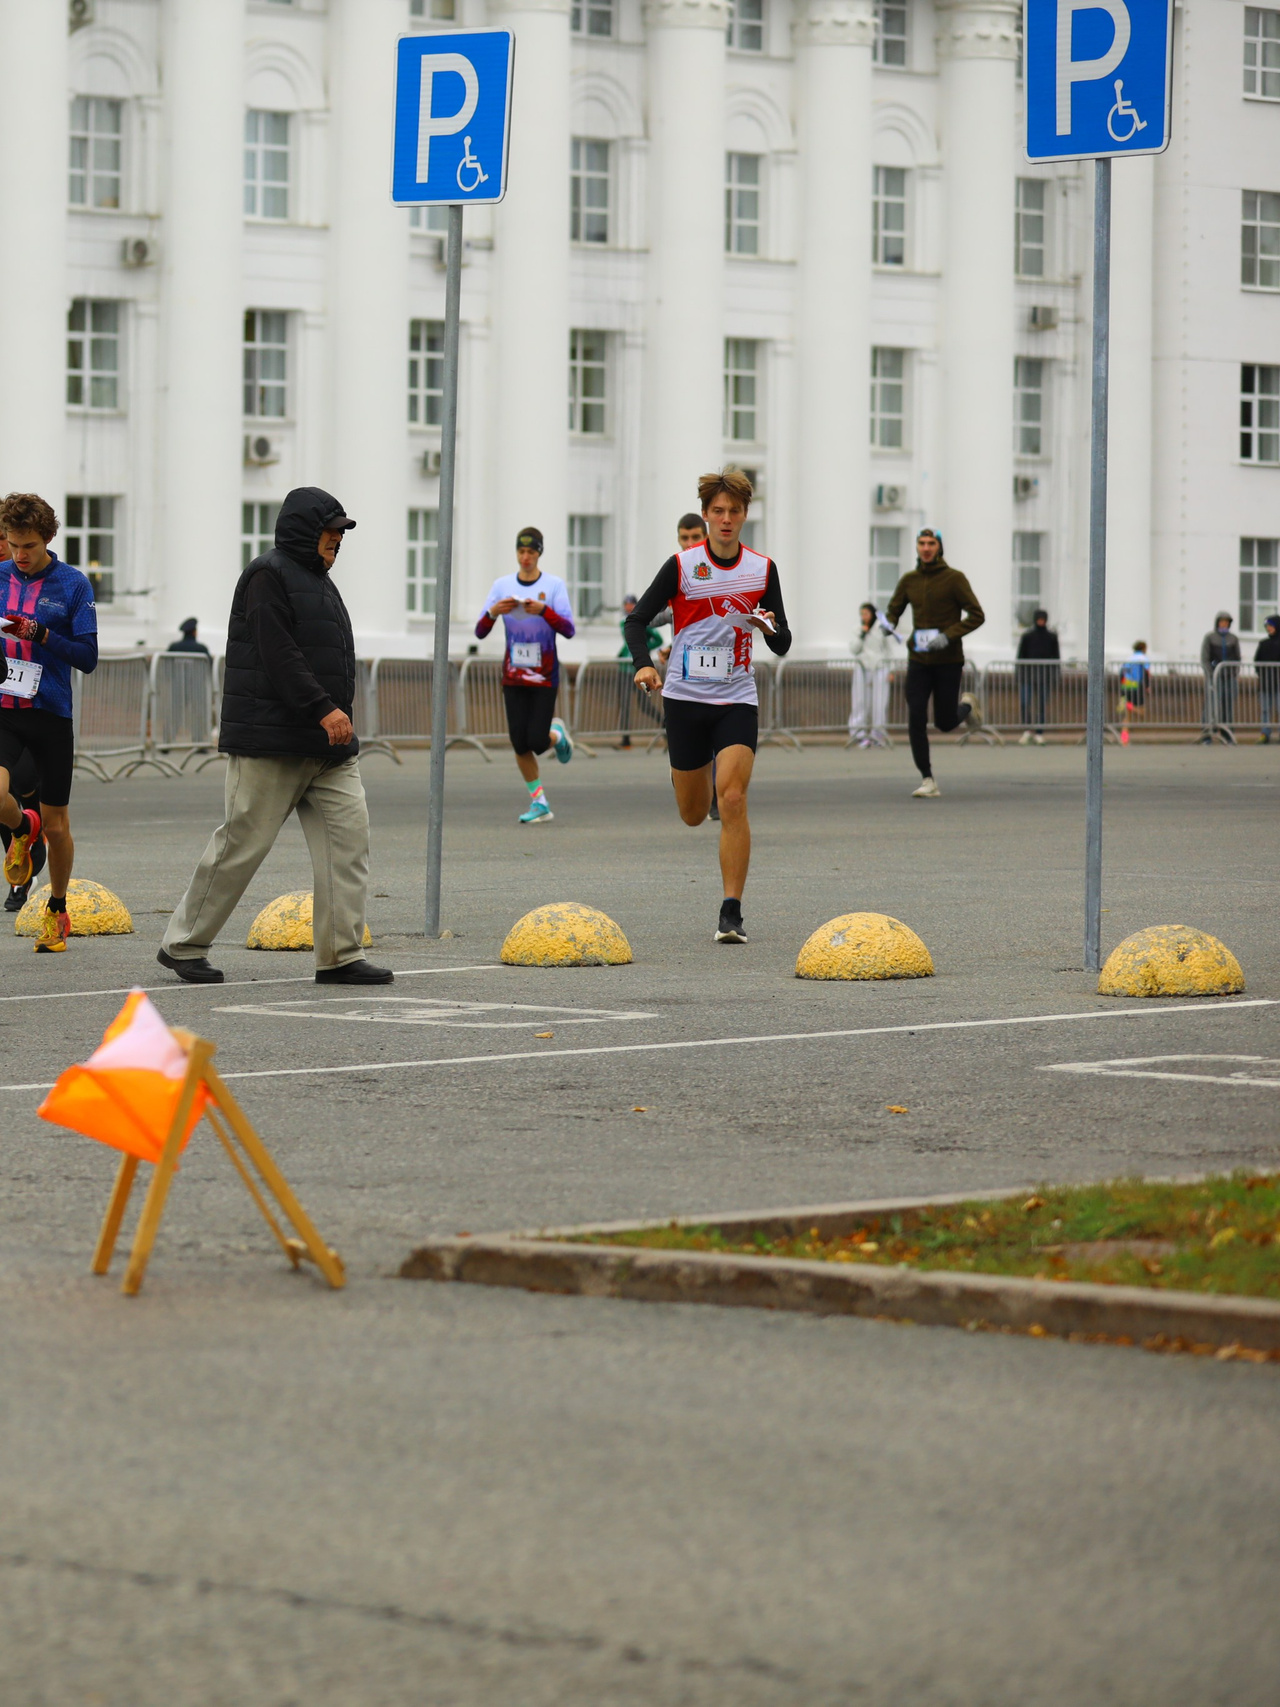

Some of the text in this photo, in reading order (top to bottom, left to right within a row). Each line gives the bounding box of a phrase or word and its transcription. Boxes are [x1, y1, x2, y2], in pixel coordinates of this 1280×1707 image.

[1056, 0, 1131, 136] P
[416, 53, 479, 183] P
[517, 649, 530, 657] 9.1
[700, 655, 717, 667] 1.1
